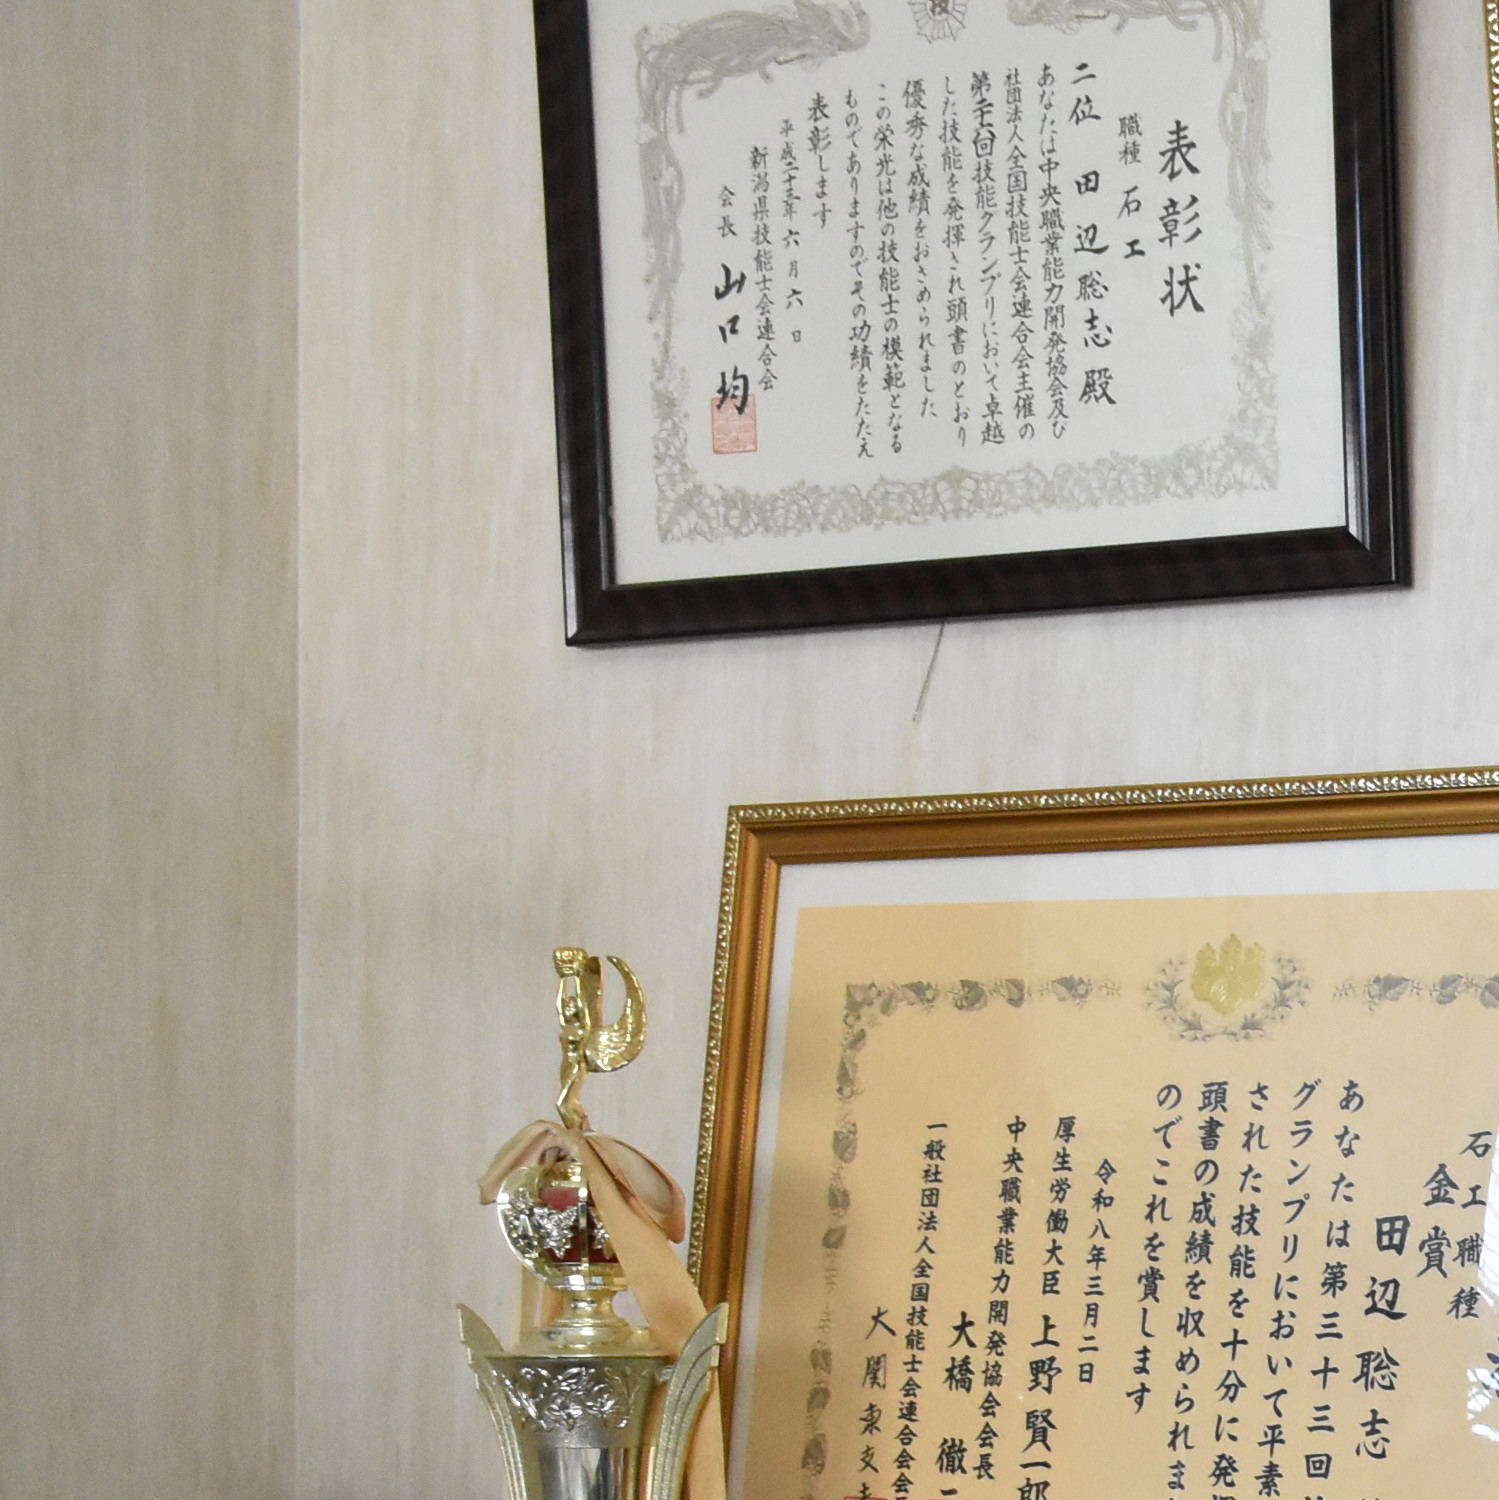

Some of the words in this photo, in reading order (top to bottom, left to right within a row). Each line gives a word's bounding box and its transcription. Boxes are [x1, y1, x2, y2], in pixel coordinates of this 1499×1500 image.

[808, 92, 833, 229] 表彰します
[1068, 62, 1101, 126] 二位
[1117, 113, 1143, 166] 職種
[717, 186, 738, 238] 会長
[750, 146, 778, 392] 新潟県技能士会連合会
[845, 88, 875, 458] ものでありますのでその功績をたたえ
[873, 83, 906, 454] この栄光は他の技能士の模範となる
[902, 78, 938, 418] 優秀な成績をおさめられました
[938, 76, 969, 448] した技能を発揮され頭書のとおり
[1003, 67, 1035, 440] 社団法人全国技能士会連合会主催の
[1037, 64, 1069, 439] あなたは中央職業能力開発協会及び
[1074, 170, 1118, 406] 田辺聡志殿
[1117, 186, 1145, 259] 石工
[1158, 119, 1205, 317] 表彰状
[714, 263, 750, 416] 山口均
[972, 1115, 1028, 1480] 中央職業能力開発協会会長
[1041, 1116, 1077, 1297] 厚生労働大臣
[1077, 1158, 1118, 1384] 令和八年三月二日
[1125, 1081, 1181, 1414] のでこれを賞します
[1416, 1163, 1460, 1278] 金賞
[1448, 1130, 1493, 1320] 石工職種
